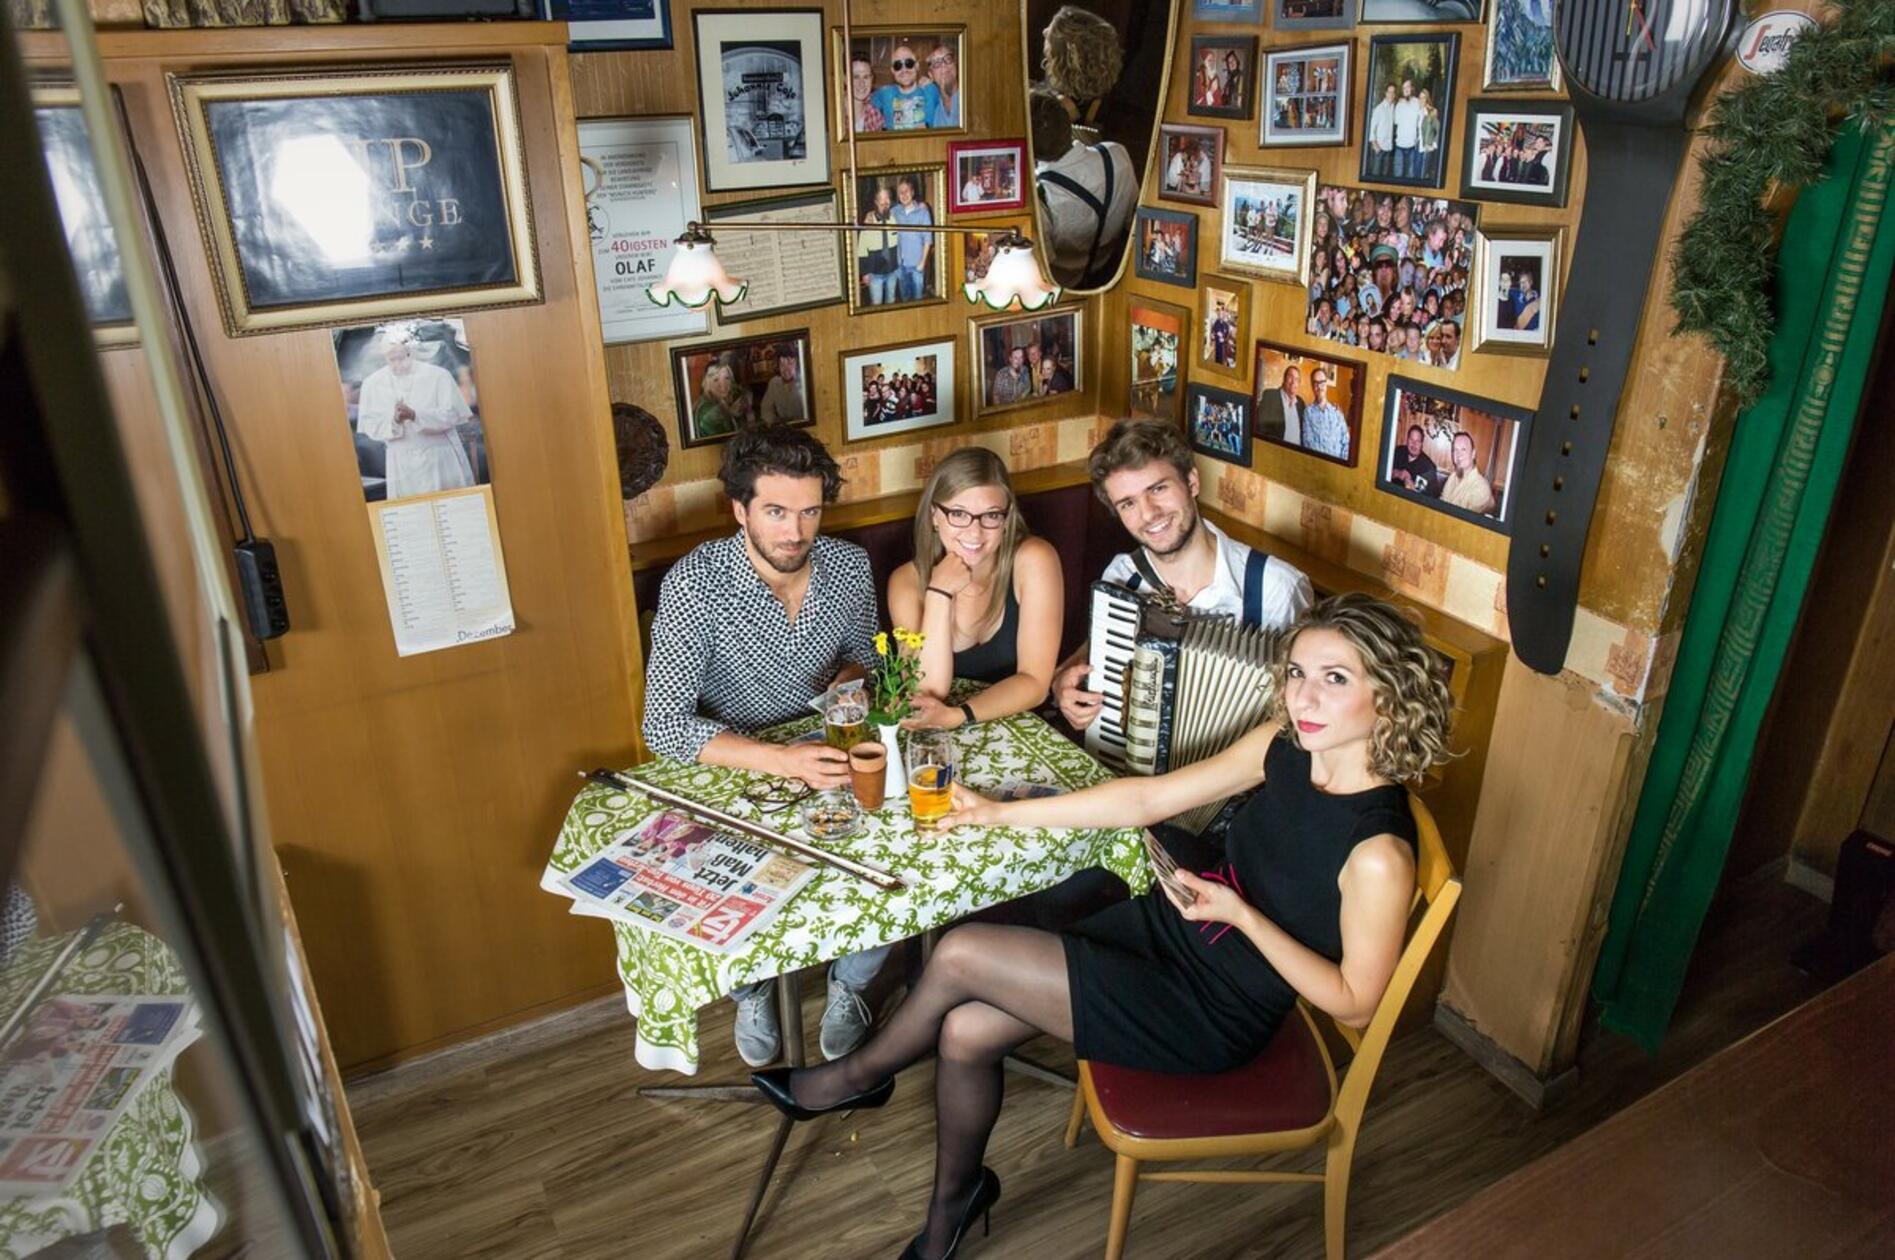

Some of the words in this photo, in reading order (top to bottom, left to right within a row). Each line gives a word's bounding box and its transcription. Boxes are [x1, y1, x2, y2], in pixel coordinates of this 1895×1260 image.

[611, 240, 667, 252] 40IGSTEN
[615, 259, 656, 275] OLAF
[706, 831, 768, 862] halten!
[710, 853, 753, 877] Maß
[692, 867, 738, 891] Jetzt
